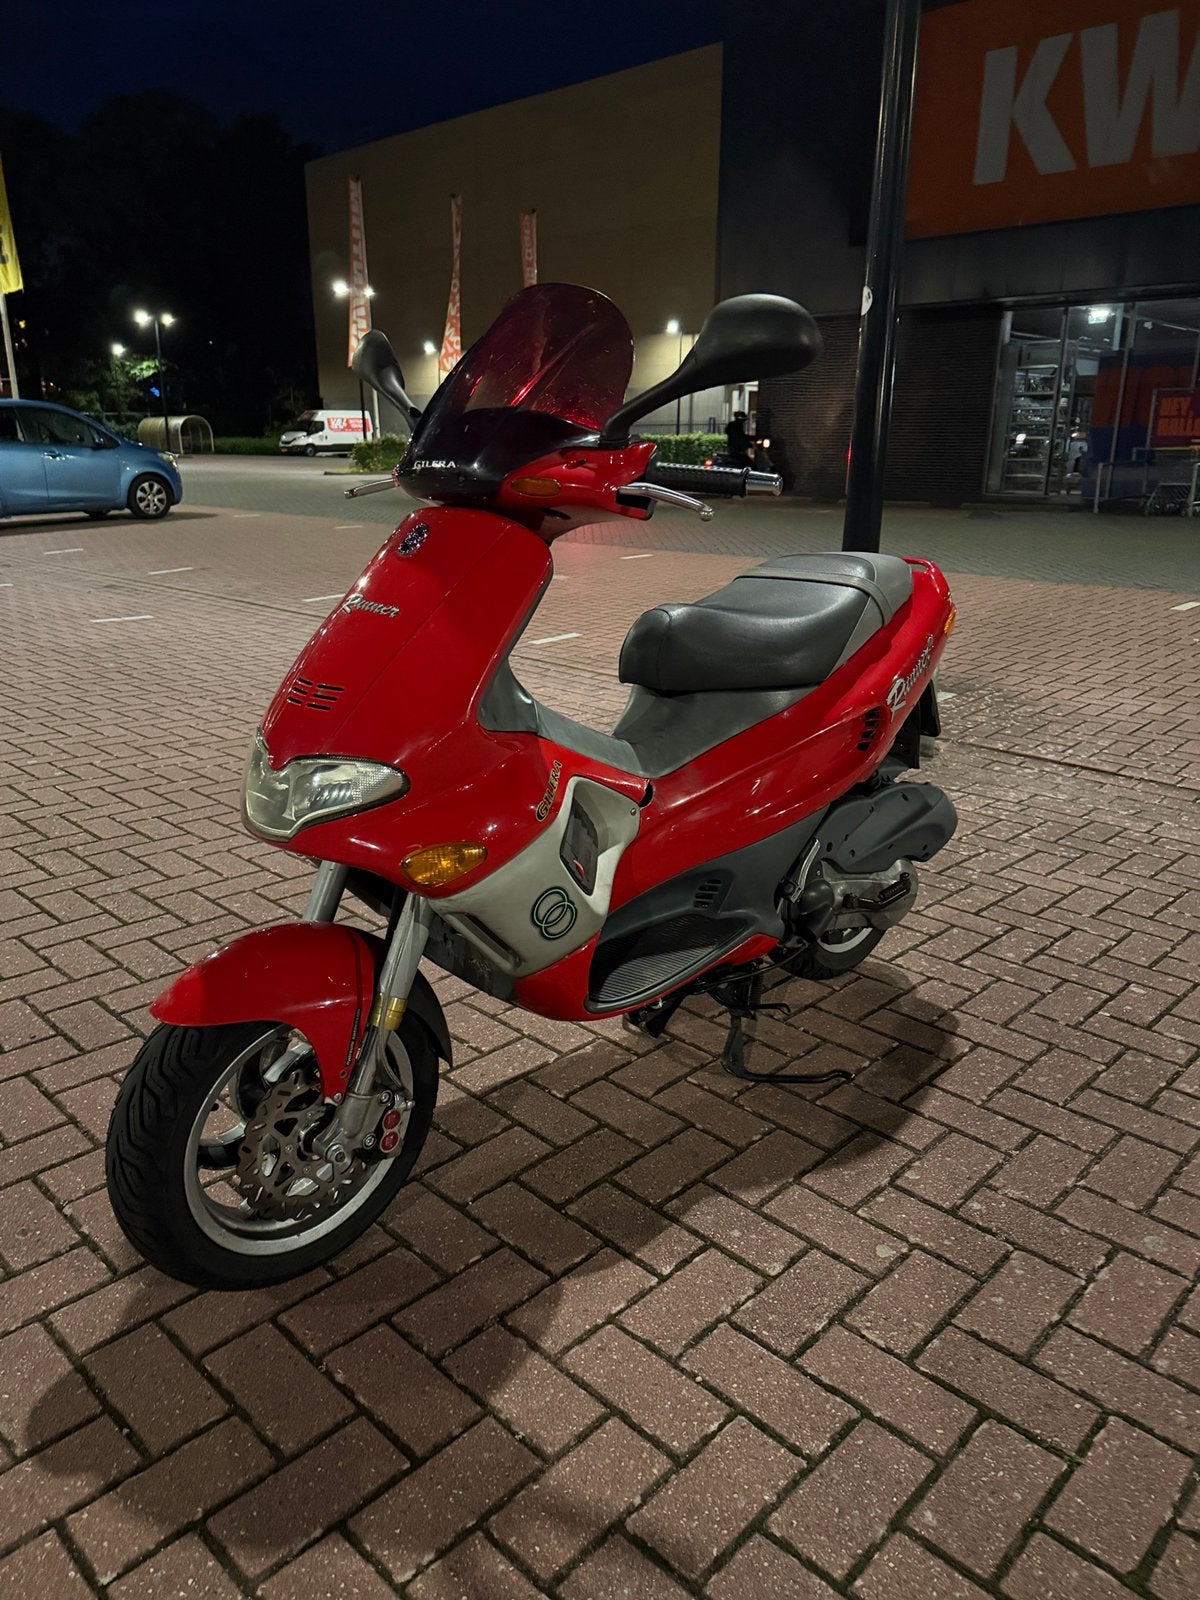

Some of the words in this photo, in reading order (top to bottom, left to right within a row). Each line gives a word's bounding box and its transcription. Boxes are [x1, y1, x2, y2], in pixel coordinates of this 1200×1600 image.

[974, 9, 1200, 186] KW
[412, 460, 456, 469] GILERA
[342, 593, 400, 618] Runner
[536, 760, 563, 821] GILERA
